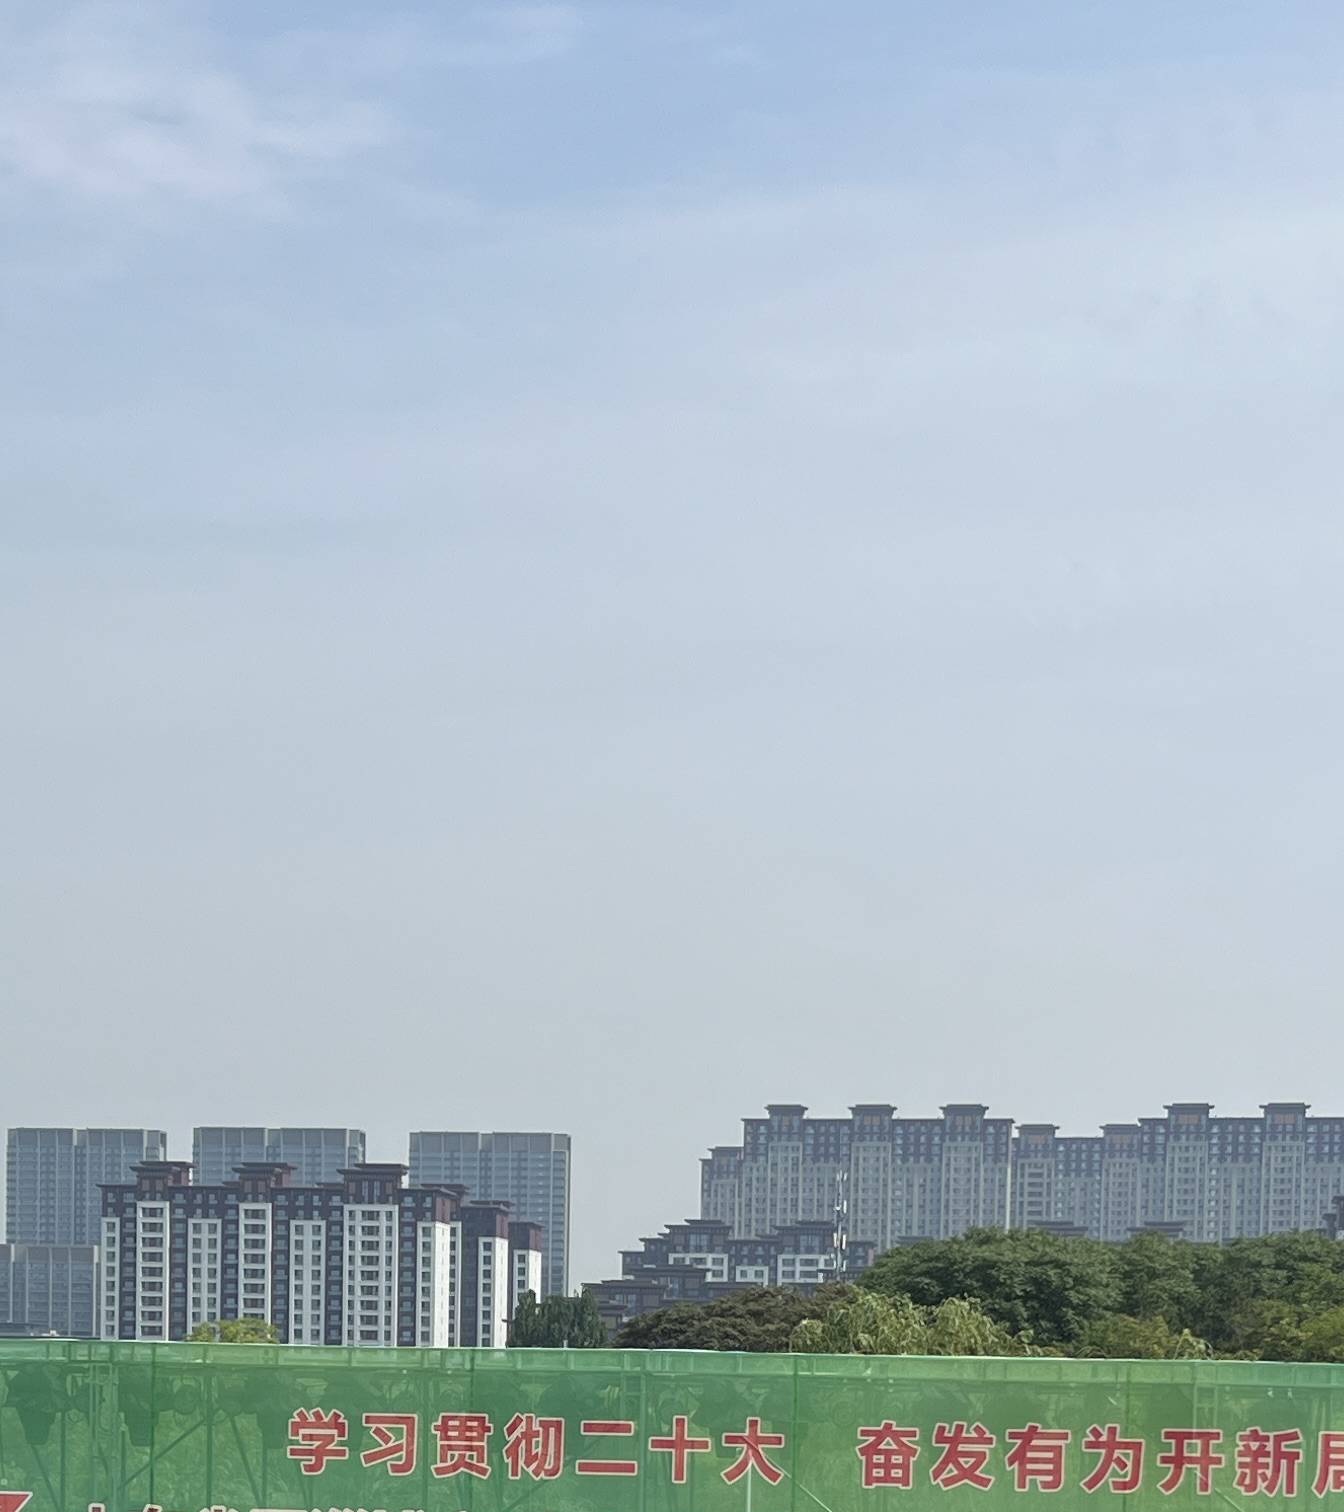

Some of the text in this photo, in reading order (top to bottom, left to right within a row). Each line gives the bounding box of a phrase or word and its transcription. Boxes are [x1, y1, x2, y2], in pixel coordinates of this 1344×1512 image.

[287, 1408, 785, 1486] 学习贯彻二十大
